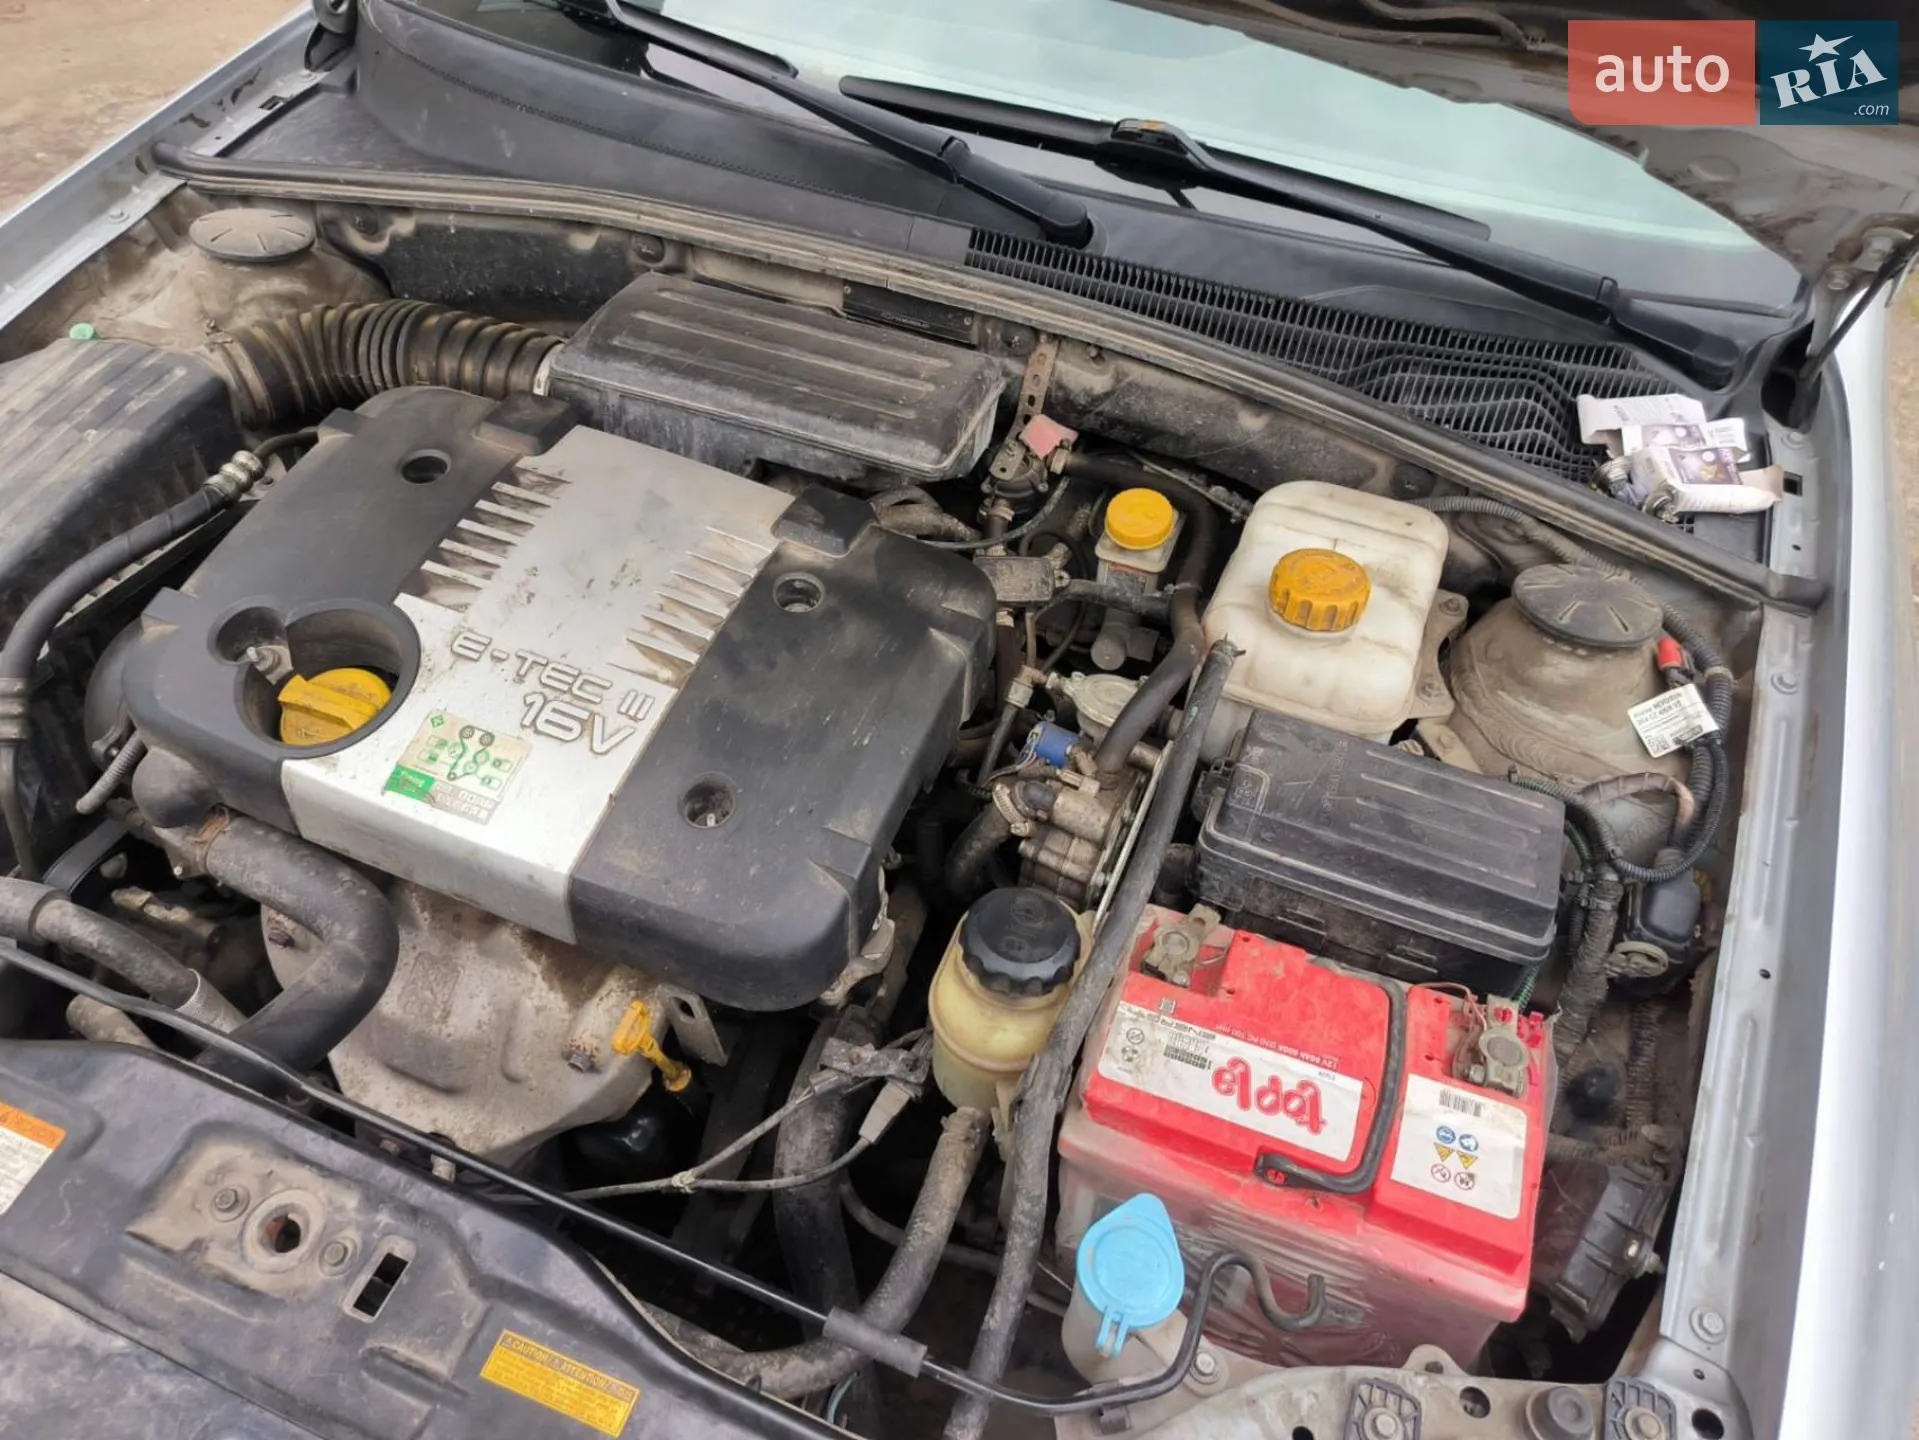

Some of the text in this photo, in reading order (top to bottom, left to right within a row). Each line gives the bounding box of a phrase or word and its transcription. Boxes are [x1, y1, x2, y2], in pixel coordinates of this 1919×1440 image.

[451, 631, 612, 704] E-TEC
[521, 691, 636, 755] 16V
[1211, 1056, 1327, 1136] topla
[511, 1339, 548, 1362] CAUTION
